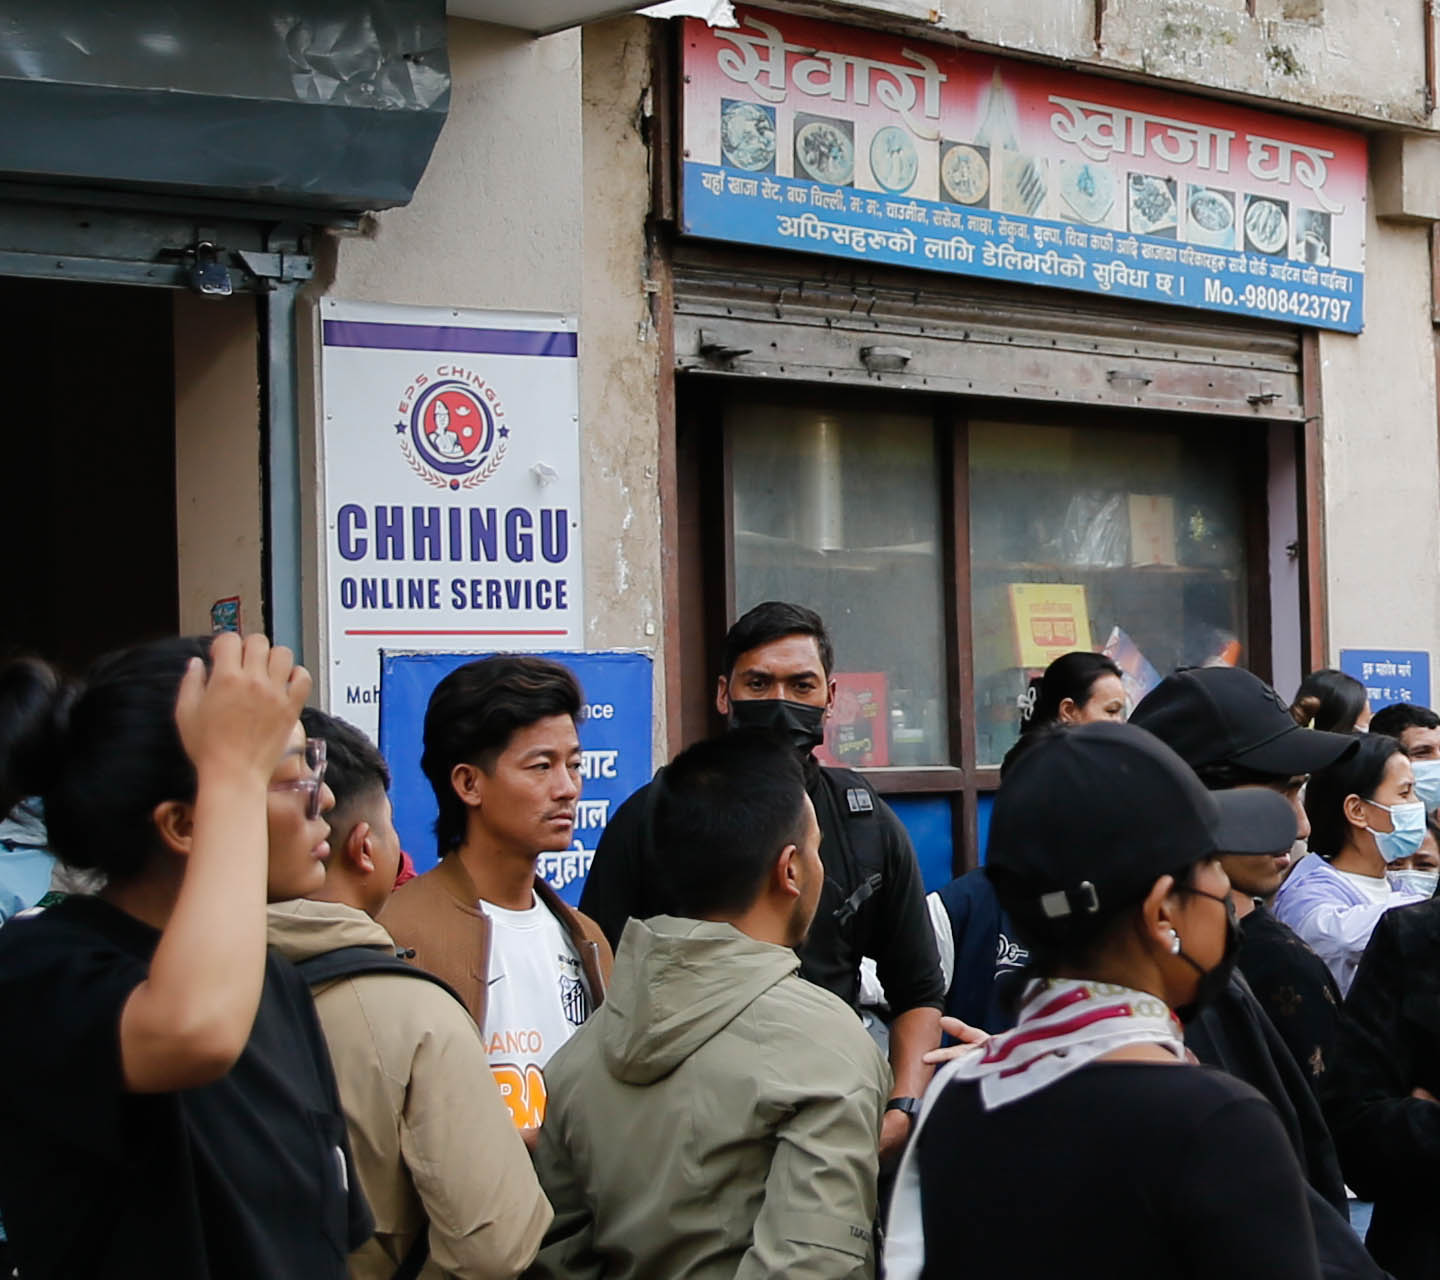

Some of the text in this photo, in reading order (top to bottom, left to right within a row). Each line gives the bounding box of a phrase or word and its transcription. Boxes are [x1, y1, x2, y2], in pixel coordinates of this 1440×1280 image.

[1048, 94, 1236, 171] खाजा
[1245, 133, 1345, 214] घर
[728, 177, 758, 198] खाजा
[924, 234, 976, 263] लागि
[1093, 260, 1150, 292] सुविधा
[398, 365, 505, 419] EPS CHINGU
[336, 503, 569, 565] CHHINGU
[340, 577, 568, 611] ONLINE SERVICE
